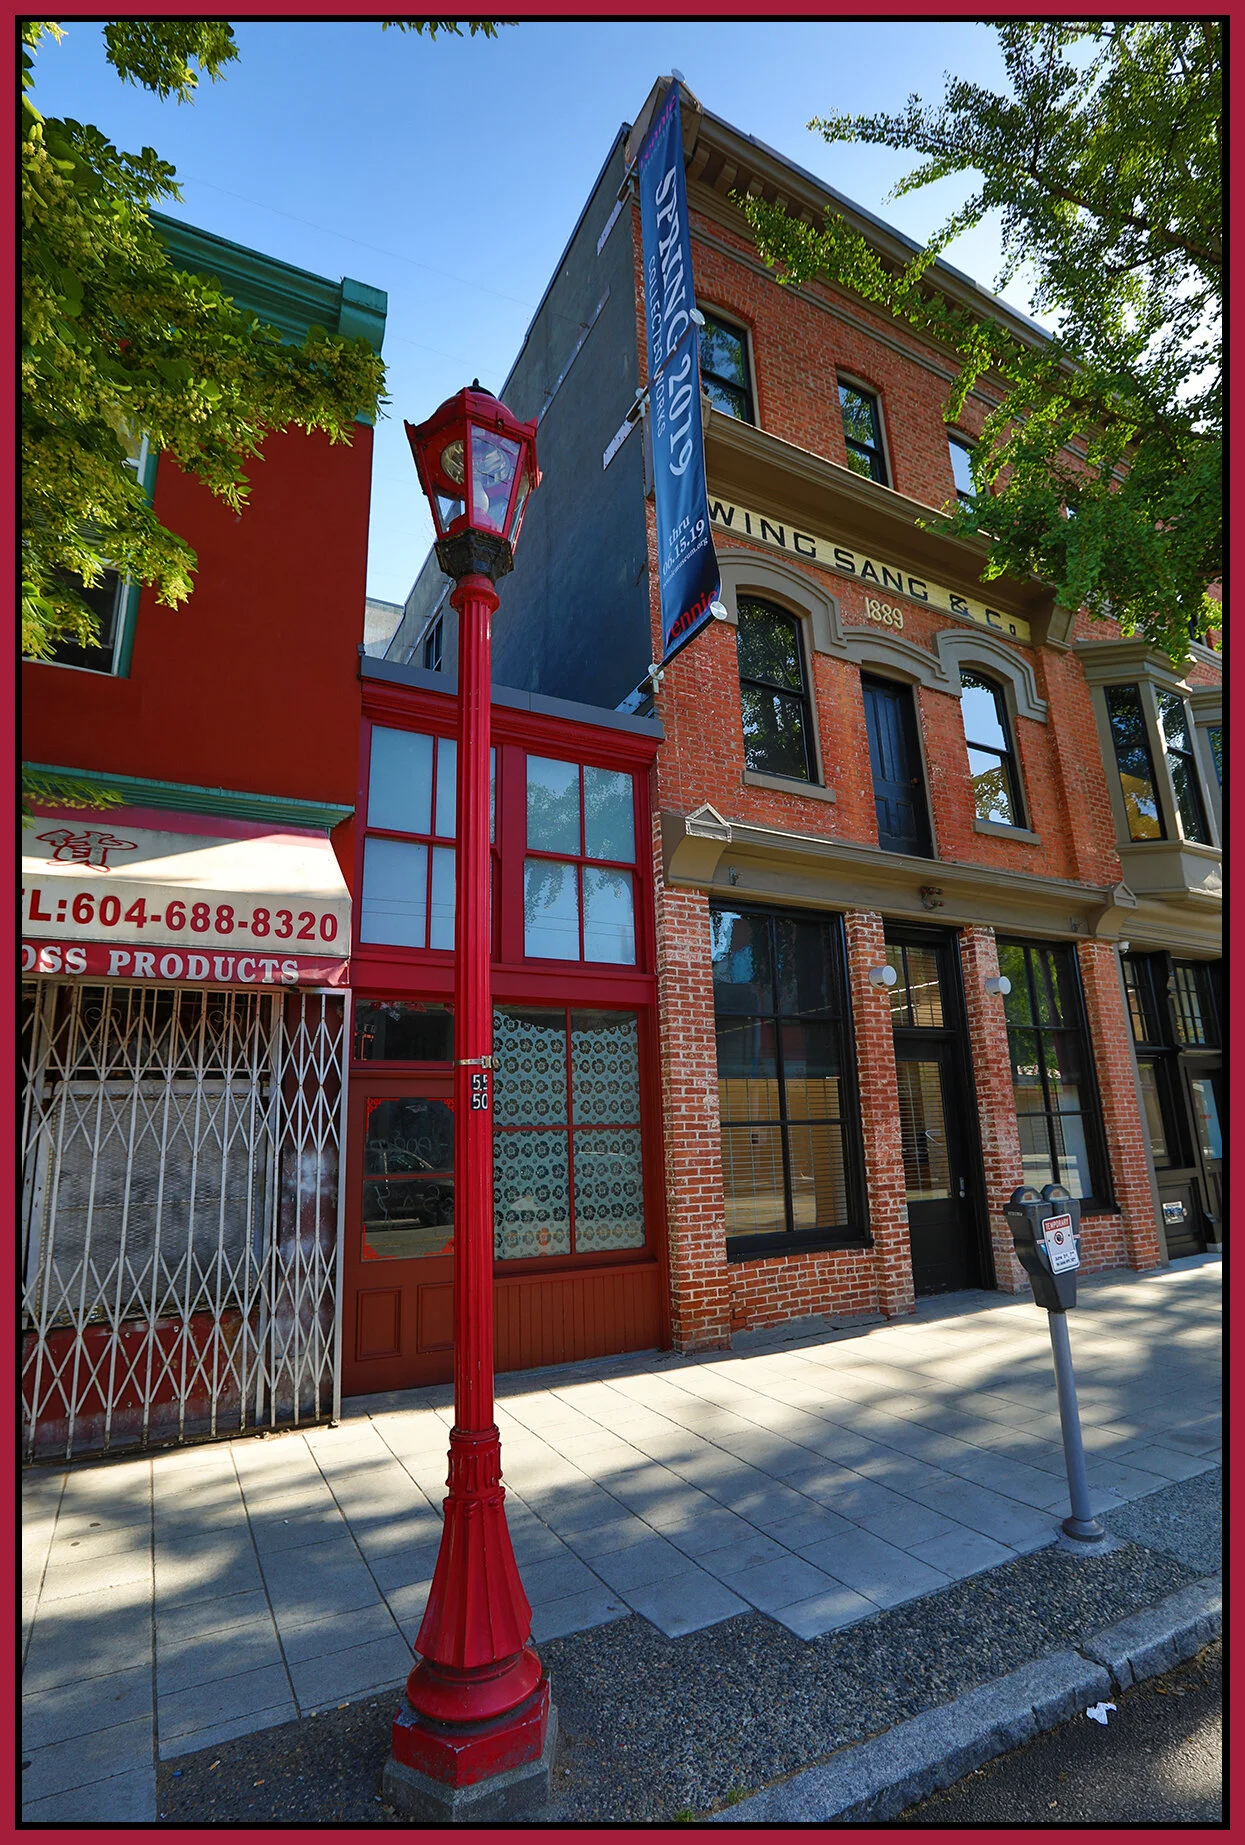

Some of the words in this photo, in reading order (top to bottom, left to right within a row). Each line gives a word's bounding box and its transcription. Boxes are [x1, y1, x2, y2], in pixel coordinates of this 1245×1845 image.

[655, 165, 689, 359] SPRING
[648, 255, 664, 363] COLLECTED
[654, 367, 666, 438] WORKS
[668, 352, 694, 477] 2019
[662, 519, 705, 576] 06.15.19
[668, 515, 690, 547] thru
[708, 501, 816, 558] WING
[834, 547, 928, 601] SANG
[949, 593, 975, 621] &
[865, 597, 905, 630] 1889
[22, 888, 339, 943] L:604-688-8320
[106, 950, 300, 985] PRODUCTS
[472, 1093, 489, 1110] 50
